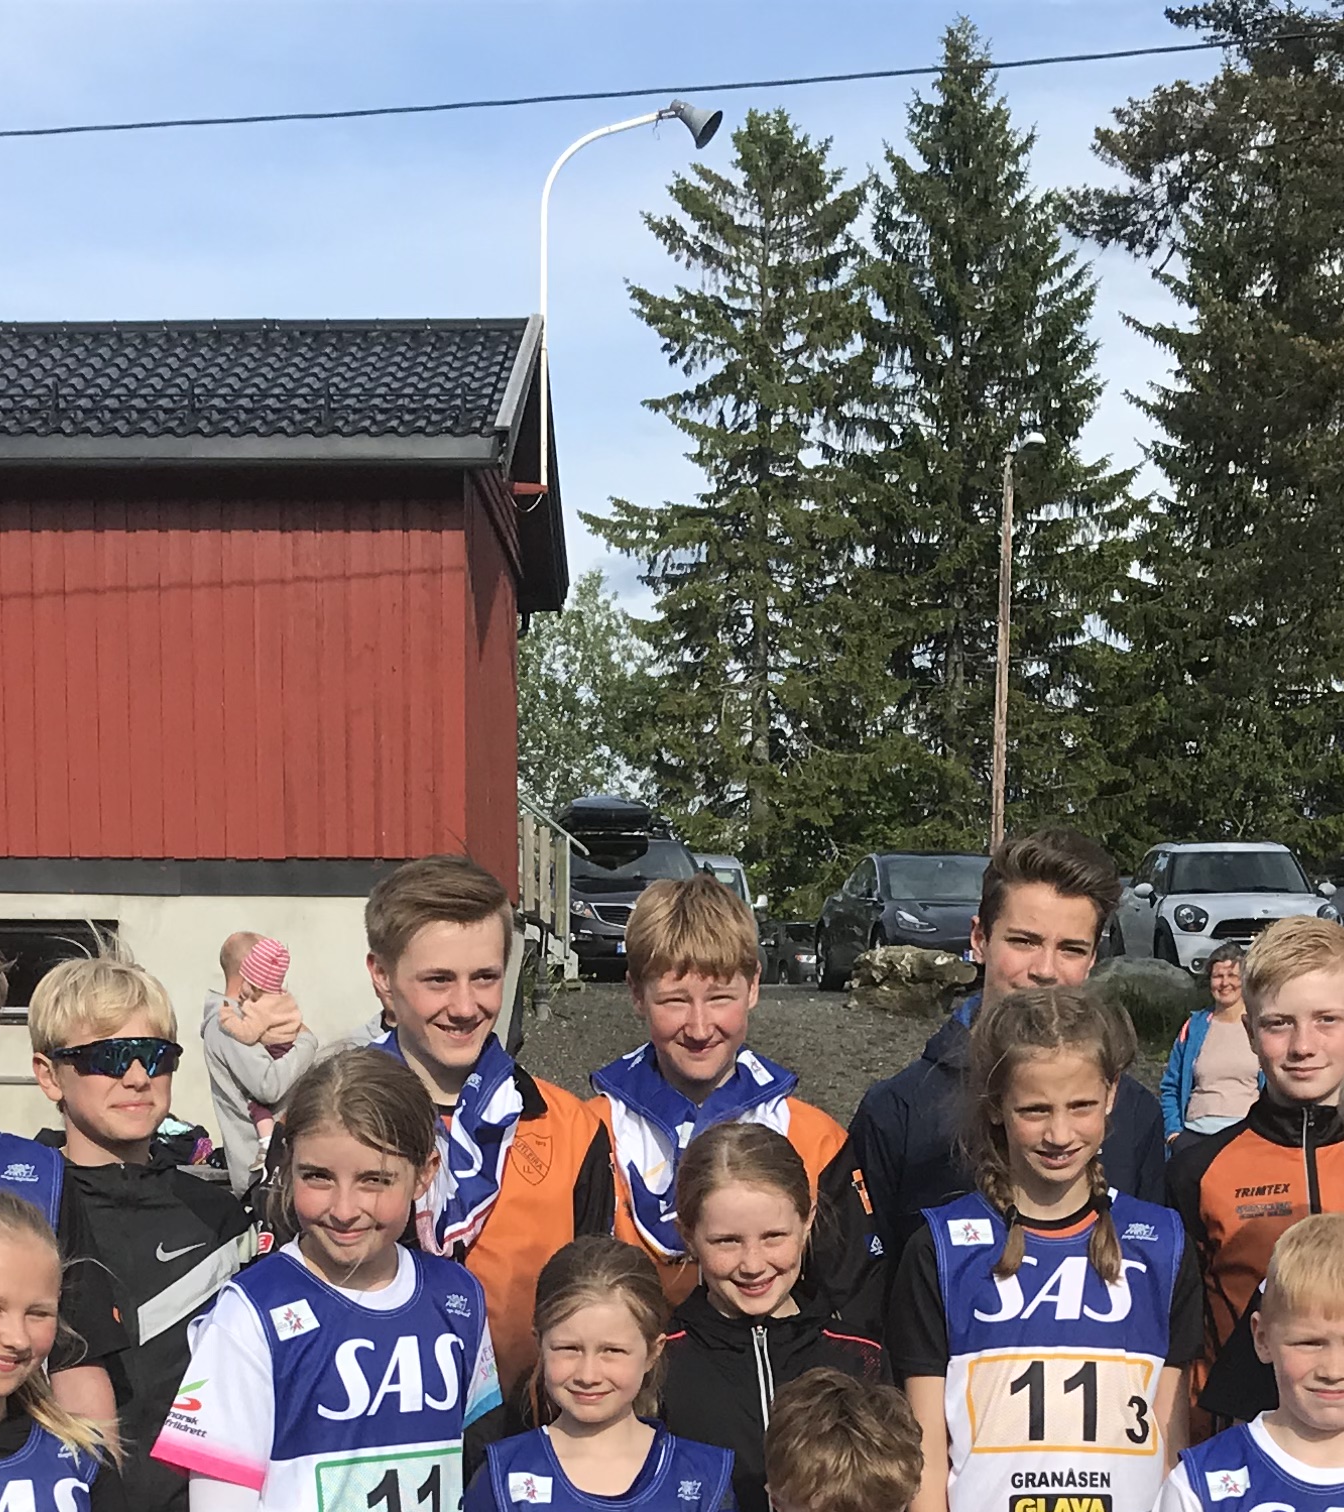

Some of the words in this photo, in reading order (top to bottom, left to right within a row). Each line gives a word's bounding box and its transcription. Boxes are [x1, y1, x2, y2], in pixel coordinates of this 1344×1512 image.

[515, 1140, 543, 1171] UTLEIRA
[1235, 1183, 1291, 1199] TRIMTEX
[974, 1254, 1147, 1323] SAS
[316, 1333, 465, 1421] SAS
[168, 1410, 199, 1426] norsk
[1009, 1361, 1097, 1442] 11
[1125, 1394, 1150, 1445] 3
[1011, 1467, 1111, 1489] GRANÅSEN
